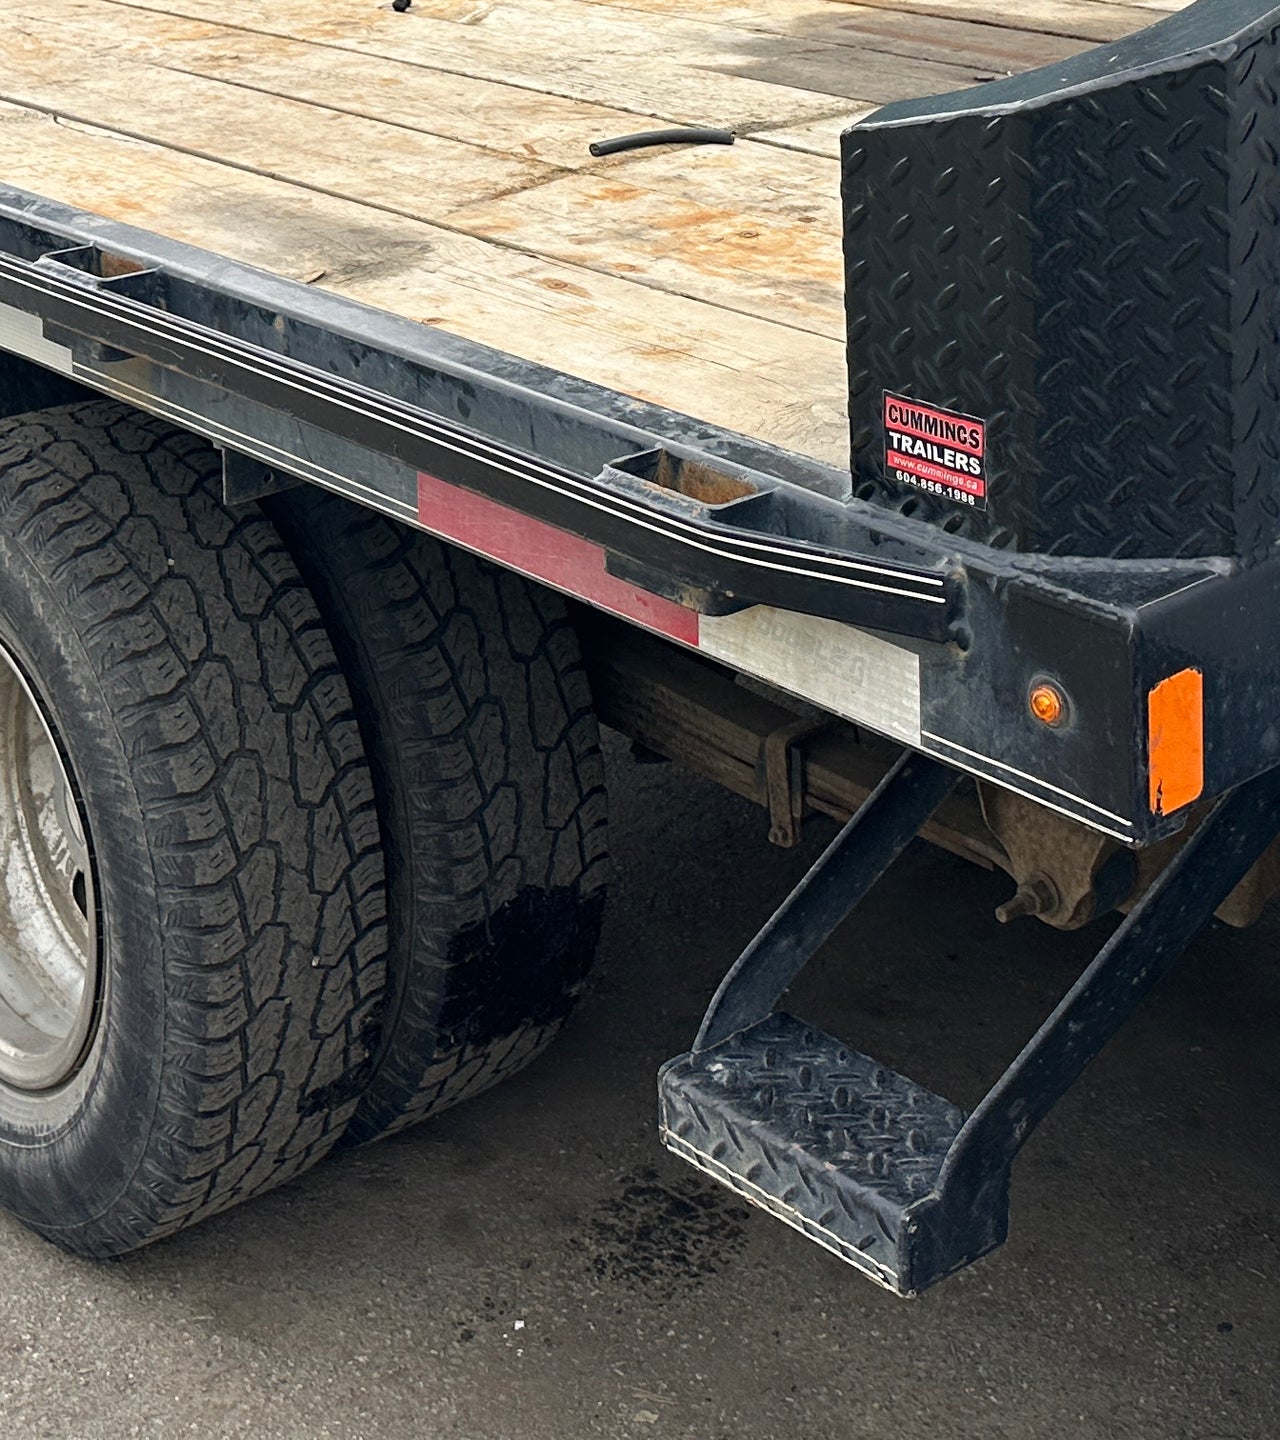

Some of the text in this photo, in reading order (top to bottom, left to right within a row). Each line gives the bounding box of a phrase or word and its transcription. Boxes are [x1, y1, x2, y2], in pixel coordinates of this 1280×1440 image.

[888, 403, 981, 450] CUMMINGS
[888, 431, 982, 476] TRAILERS
[892, 455, 979, 490] www.cummings.ca
